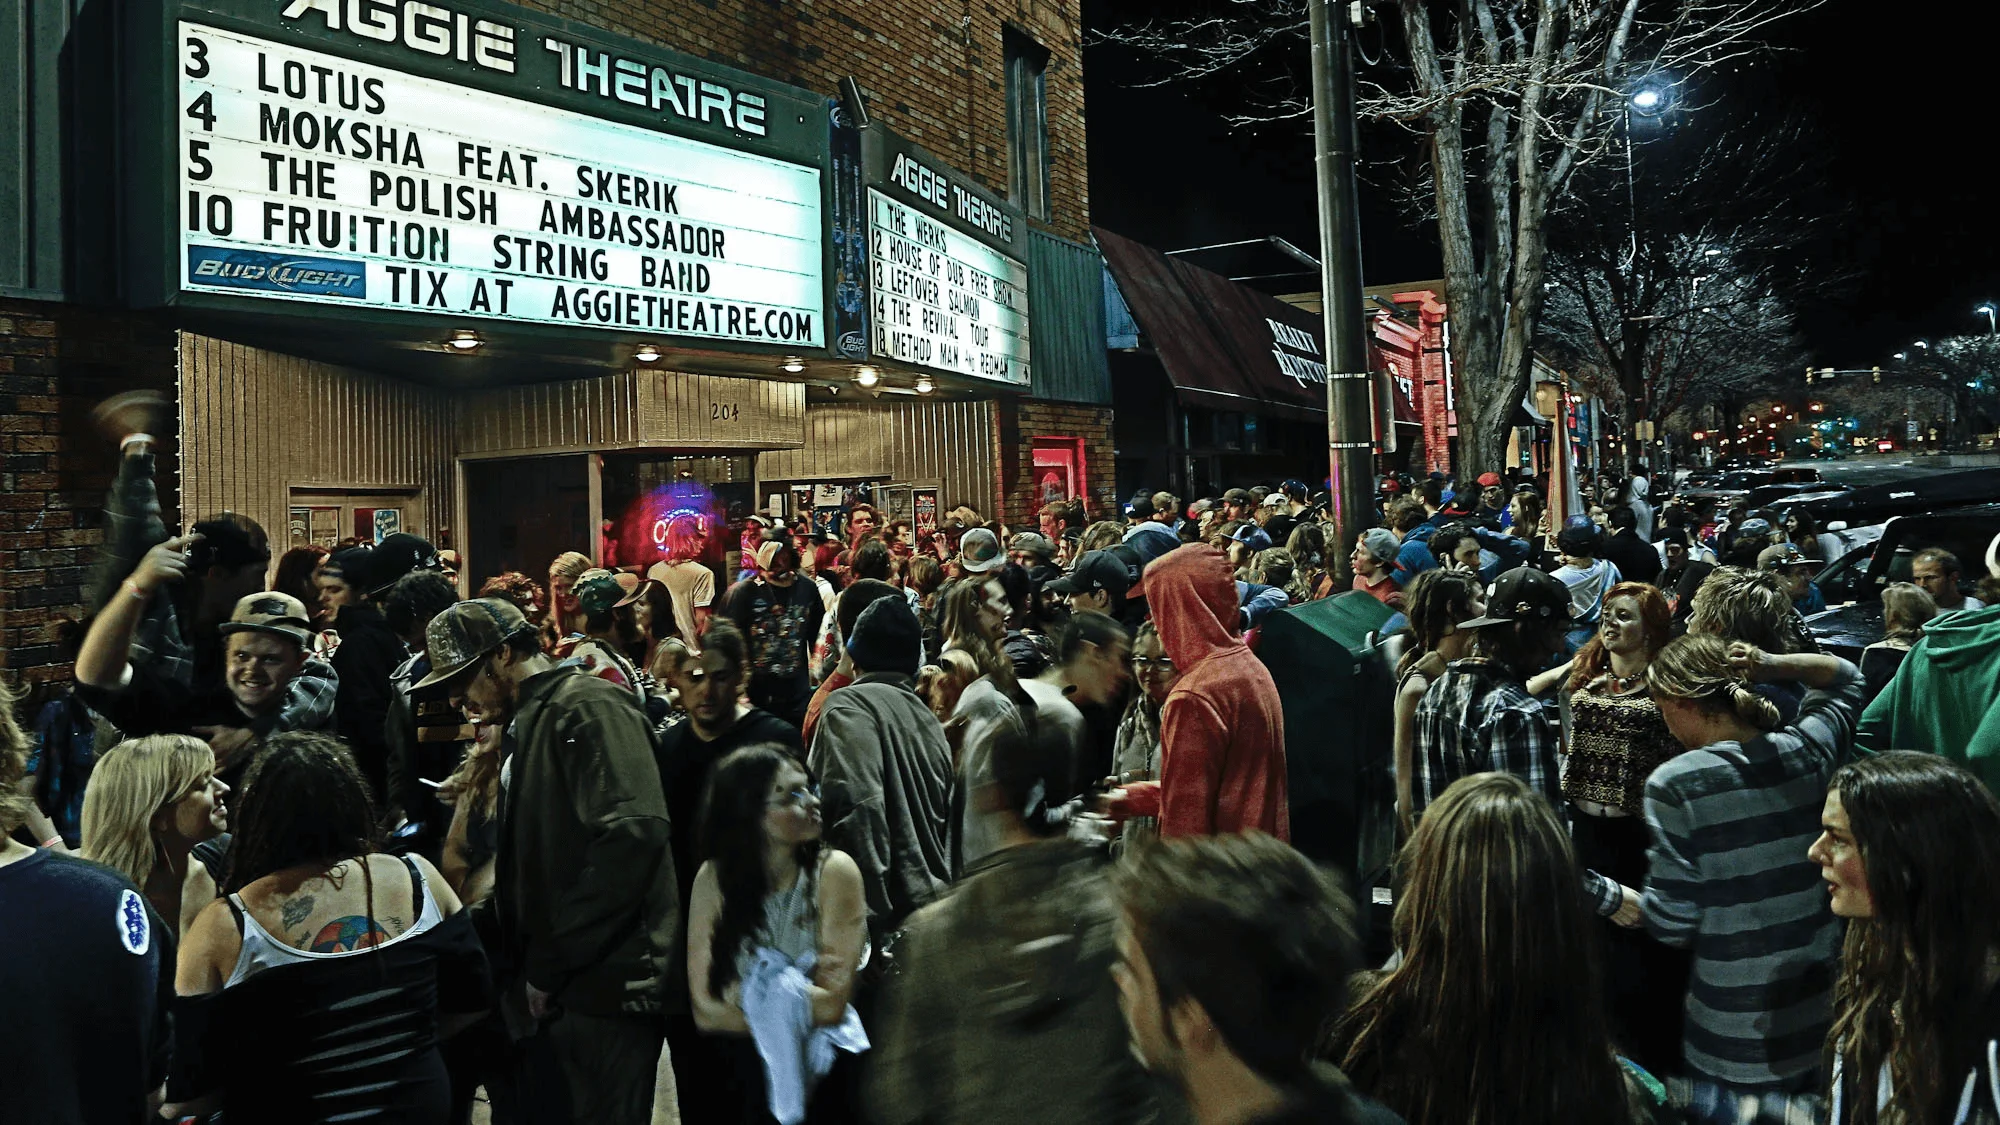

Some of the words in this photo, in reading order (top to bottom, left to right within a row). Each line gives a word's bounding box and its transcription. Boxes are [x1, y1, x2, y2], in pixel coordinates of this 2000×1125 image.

[185, 37, 210, 79] 3
[258, 52, 386, 115] LOTUS
[282, 0, 515, 73] AGGIE
[545, 38, 766, 136] THEATRE
[186, 90, 217, 132] 4
[260, 102, 425, 169] MOKSHA
[458, 141, 549, 190] FEAT.
[577, 165, 679, 215] SKERIK
[188, 139, 213, 181] 5
[261, 151, 337, 200] THE
[370, 169, 498, 225] POLISH
[539, 200, 725, 259] AMBASSADOR
[871, 197, 879, 223] 11
[888, 203, 907, 236] THE
[915, 217, 947, 252] WERKS
[890, 152, 948, 210] AGGIE
[954, 185, 1012, 244] THEATRE
[188, 190, 233, 237] 10
[263, 201, 449, 263] FRUITION
[493, 234, 609, 281] STRING
[641, 255, 711, 293] BAND
[194, 259, 265, 281] BUD
[275, 265, 360, 288] LIGHT
[871, 227, 883, 257] 12
[889, 235, 922, 271] HOUSE
[930, 252, 941, 276] OF
[947, 259, 965, 287] DUB
[970, 270, 988, 297] FREE
[993, 279, 1013, 308] SHOW
[386, 266, 448, 308] TIX
[469, 277, 514, 314] AT
[551, 285, 812, 342] AGGIETHEATRE.COM
[872, 260, 883, 288] 13
[891, 266, 940, 306] LEFTOVER
[949, 288, 980, 320] SALMON
[873, 292, 885, 320] 14
[891, 298, 911, 327] THE
[922, 307, 959, 340] REVIVAL
[970, 322, 989, 348] TOUR
[840, 342, 866, 353] LIGHT
[845, 335, 865, 346] BUD
[876, 326, 886, 353] 18
[892, 330, 932, 362] METHOD
[940, 342, 959, 368] MAN
[980, 352, 1009, 380] REDMAN
[712, 403, 739, 422] 204
